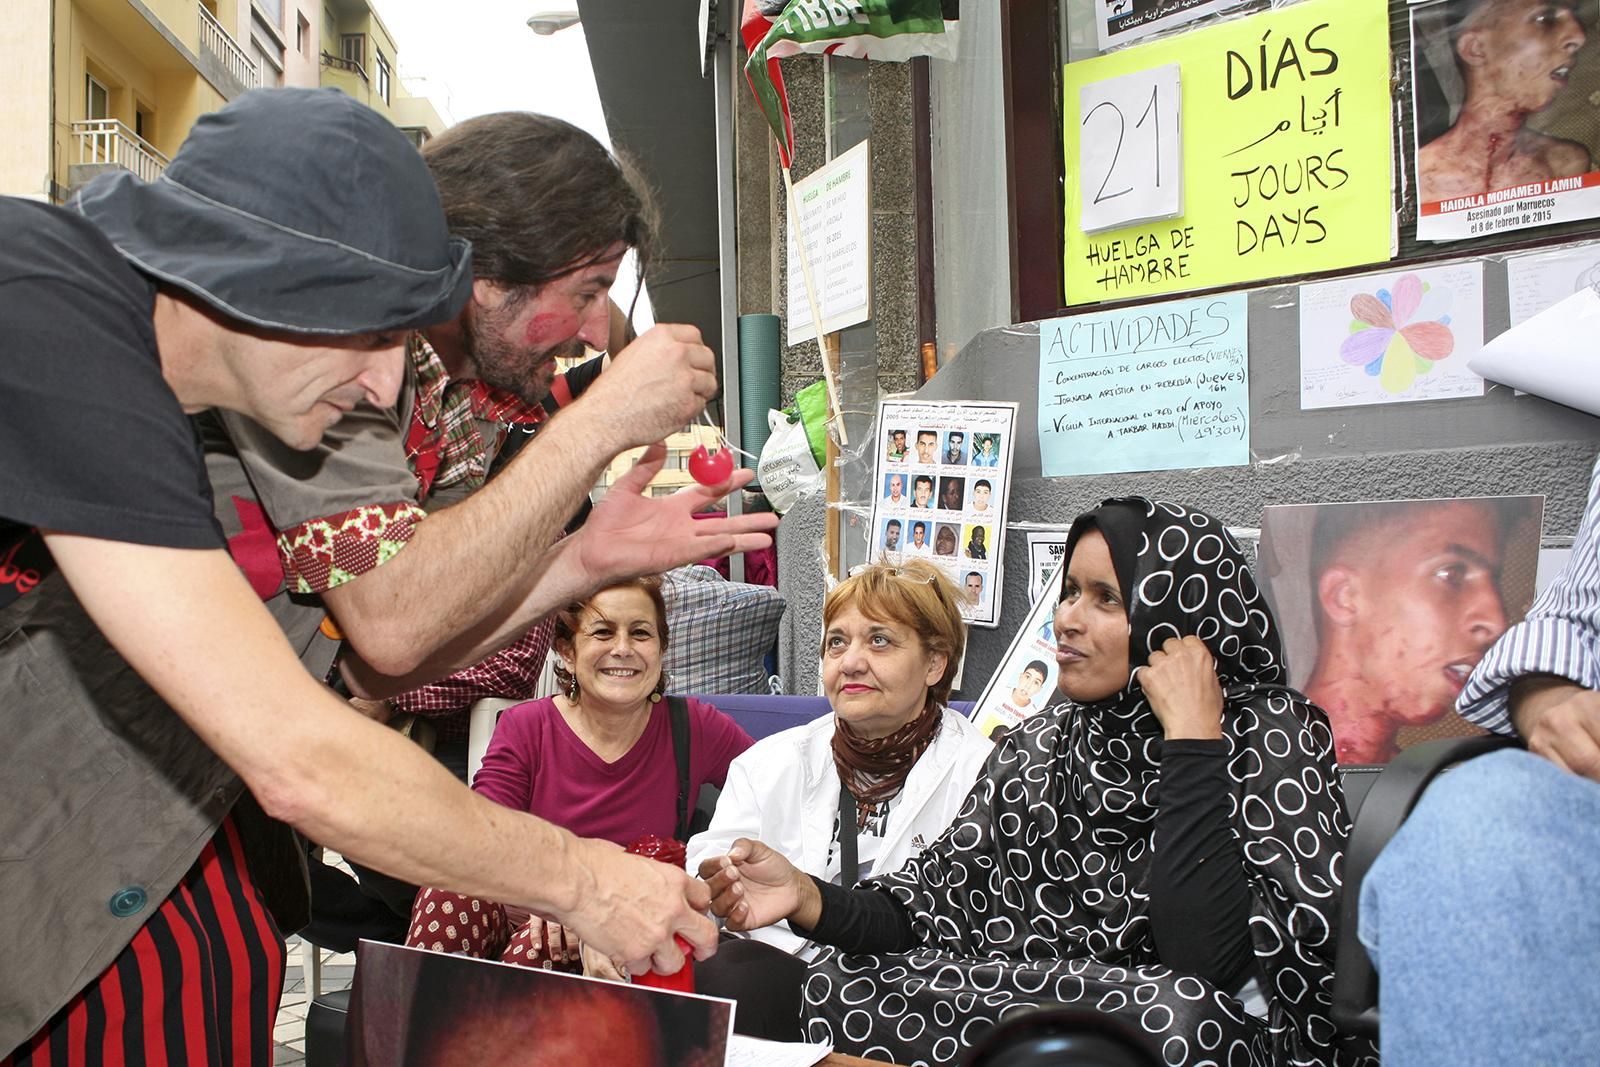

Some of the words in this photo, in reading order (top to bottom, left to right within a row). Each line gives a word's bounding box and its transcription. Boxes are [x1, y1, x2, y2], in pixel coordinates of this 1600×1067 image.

[1226, 24, 1339, 101] DÍAS
[1082, 84, 1161, 205] 21
[1231, 149, 1349, 209] JOURS
[1440, 195, 1485, 213] HAIDALA
[1487, 184, 1542, 205] MOHAMED
[1544, 176, 1582, 194] LAMIN
[1467, 207, 1502, 222] Asesinado
[1504, 203, 1515, 217] por
[1516, 198, 1556, 212] Marruecos
[1471, 222, 1478, 234] el
[1479, 222, 1484, 232] 8
[1485, 220, 1494, 231] de
[1495, 214, 1520, 229] febrero
[1521, 213, 1531, 225] de
[1532, 210, 1552, 222] 2015
[1086, 234, 1160, 266] HUELGA
[1171, 226, 1195, 250] DE
[1236, 206, 1327, 256] DAYS
[1096, 254, 1192, 291] HAMBRE
[1048, 301, 1230, 358] ACTIVIDADES
[1119, 363, 1130, 373] DE
[1136, 360, 1168, 371] CARGOS
[1173, 354, 1207, 365] ELECTOS
[1140, 384, 1152, 392] EN
[1176, 396, 1192, 413] EN
[1193, 400, 1223, 411] APOYO
[1208, 384, 1227, 392] 16h
[1107, 431, 1114, 439] A
